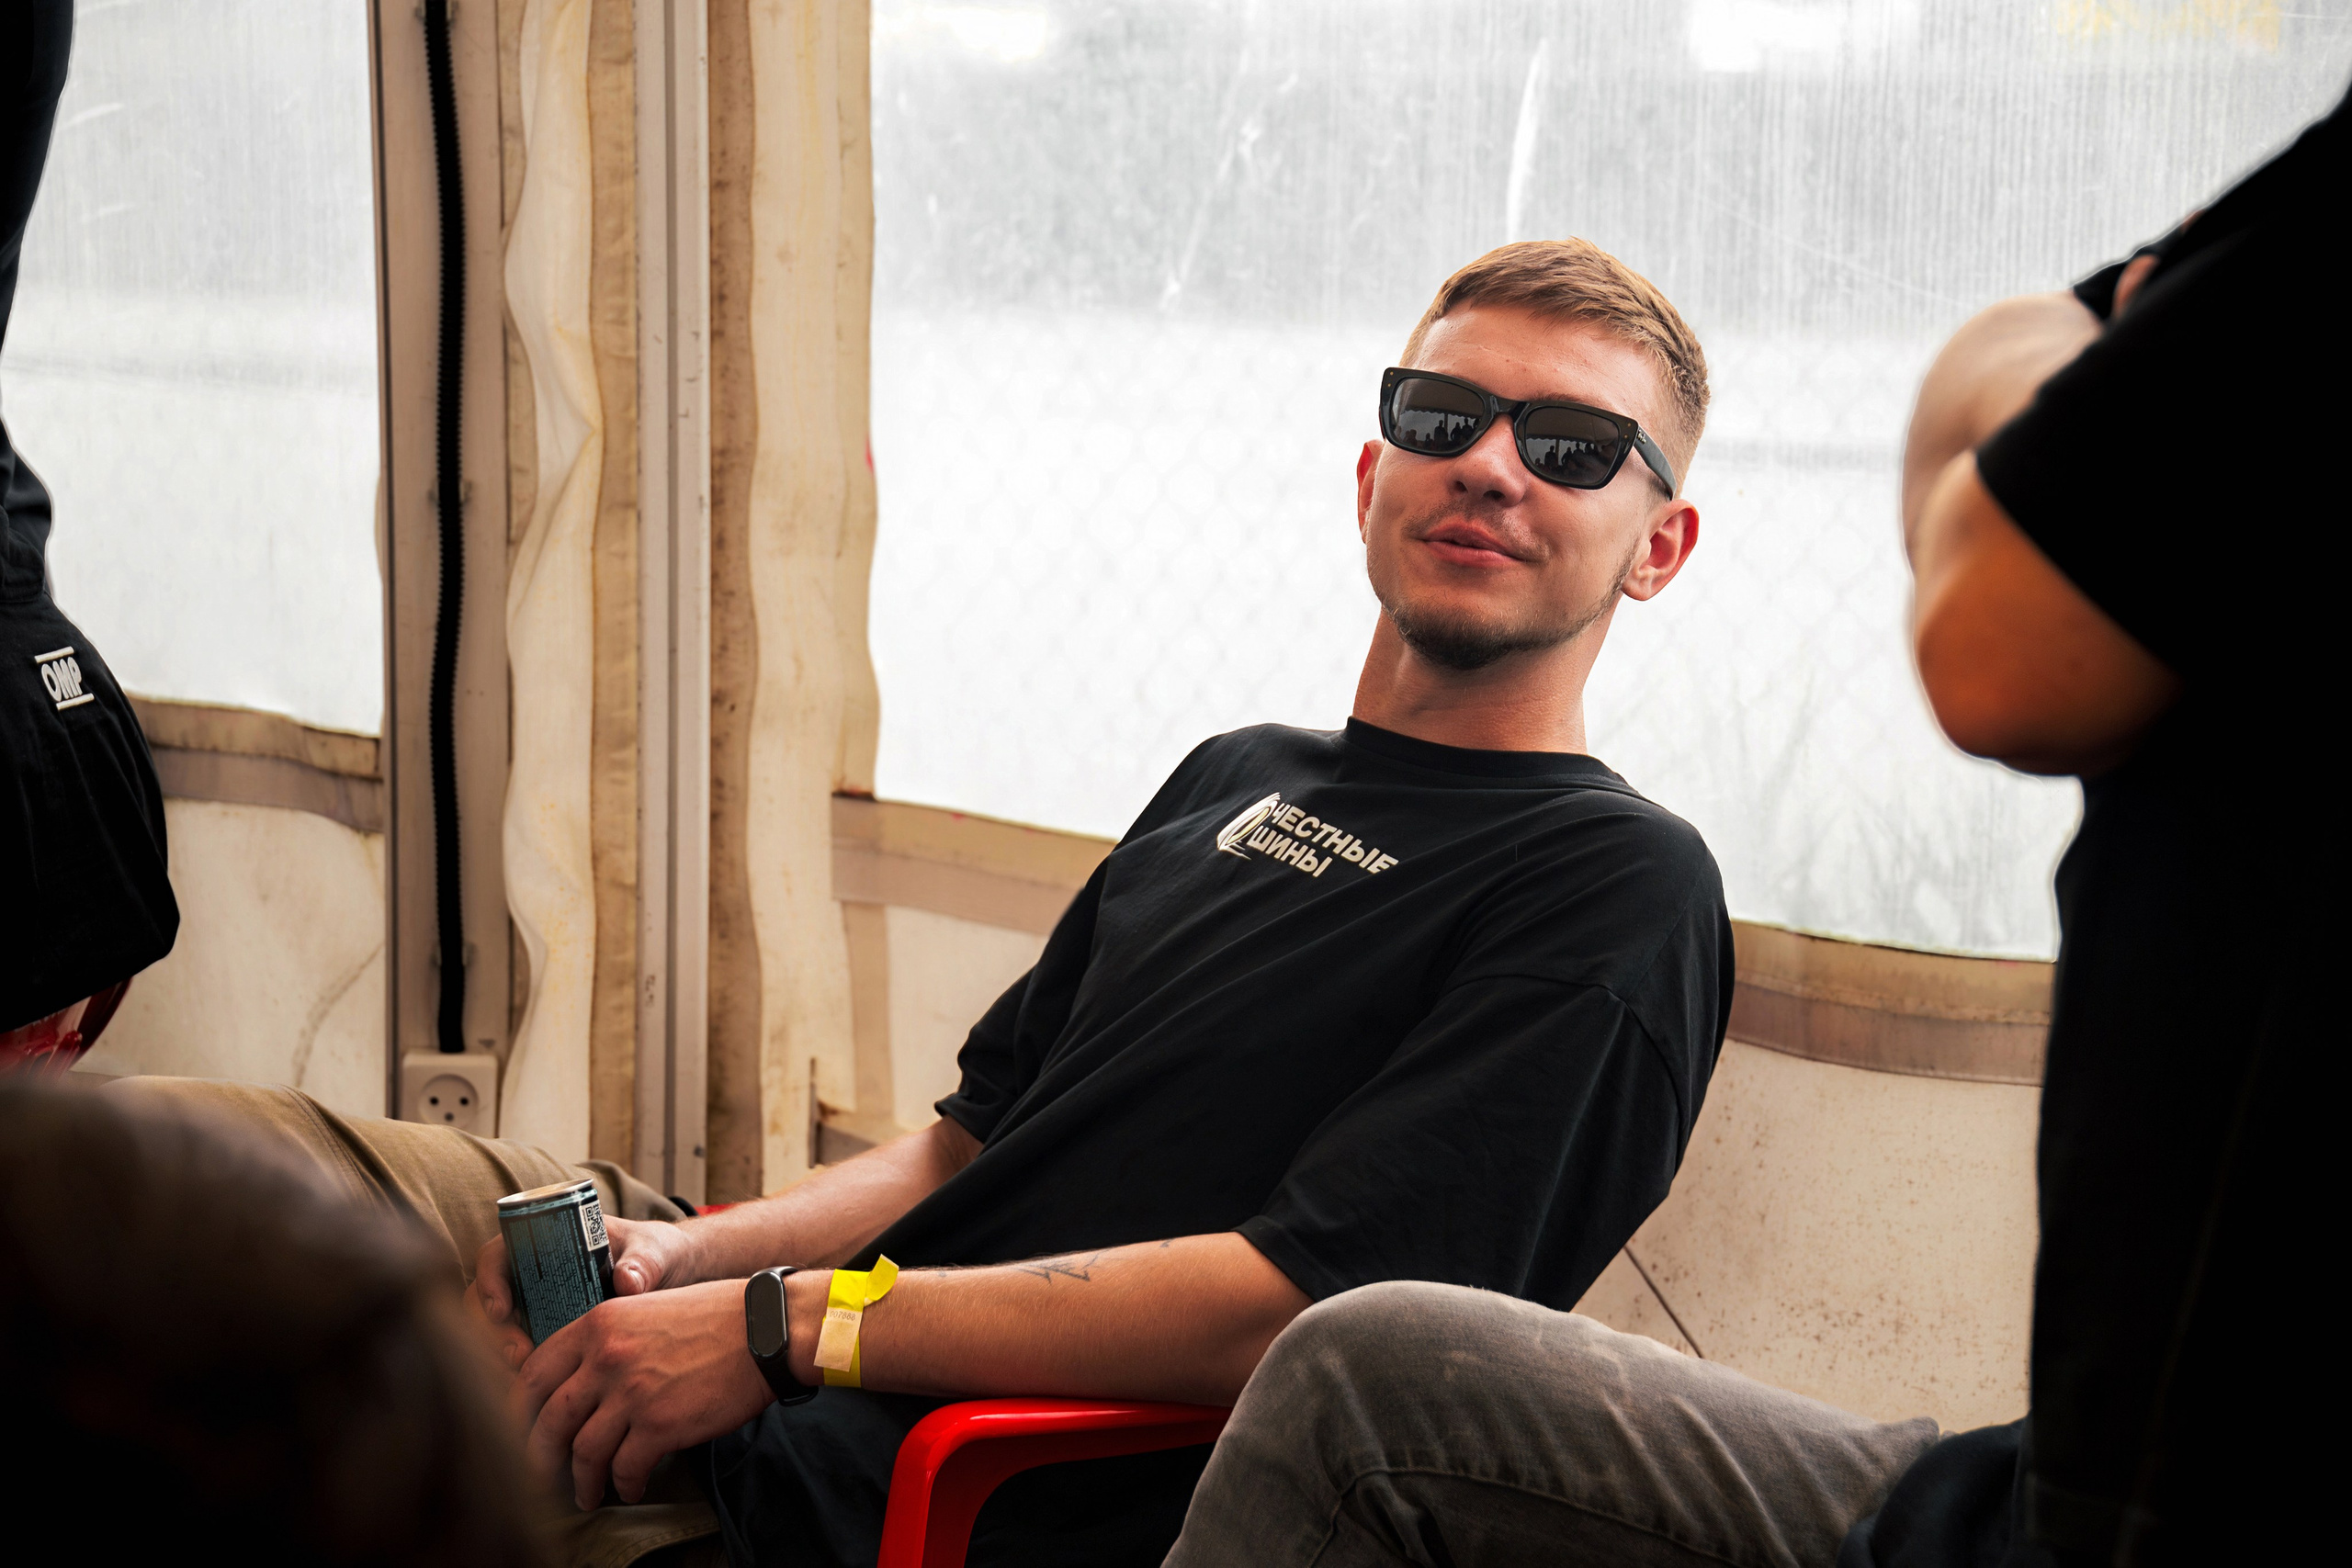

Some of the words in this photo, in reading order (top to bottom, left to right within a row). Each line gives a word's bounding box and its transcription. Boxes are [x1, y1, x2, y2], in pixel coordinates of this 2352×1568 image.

[41, 656, 83, 702] OMP
[1246, 825, 1333, 877] ШИНЫ
[1272, 802, 1399, 874] ЧЕСТНЫЕ
